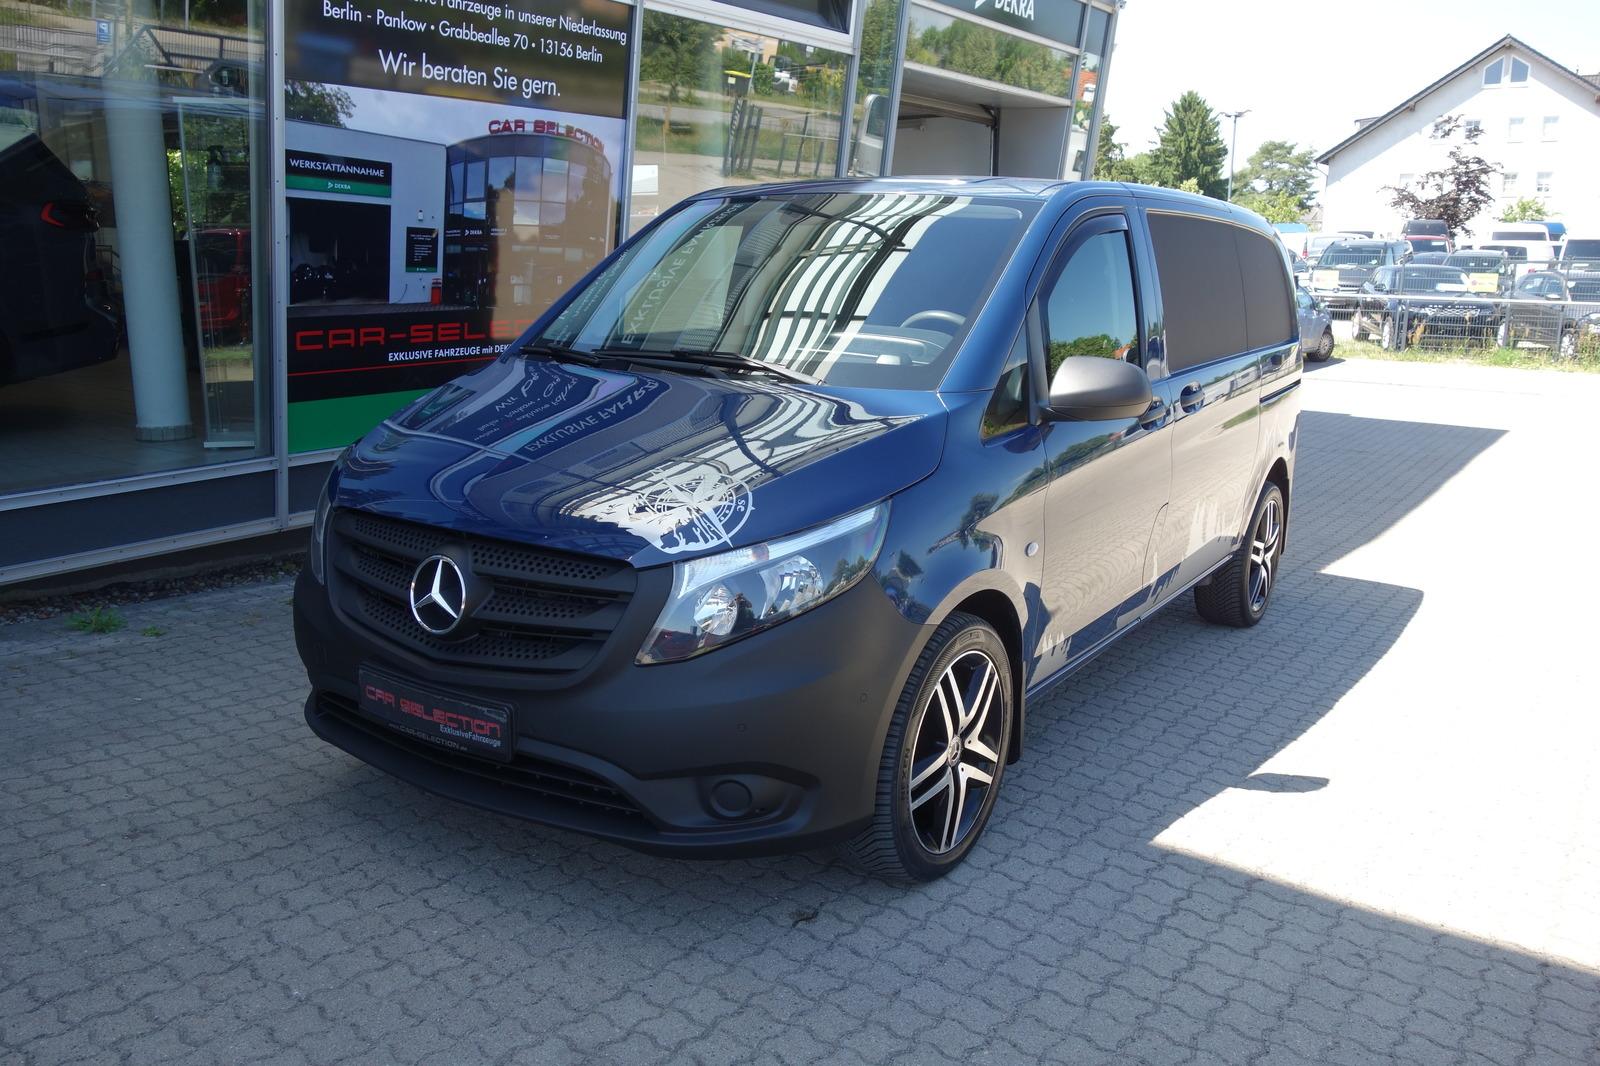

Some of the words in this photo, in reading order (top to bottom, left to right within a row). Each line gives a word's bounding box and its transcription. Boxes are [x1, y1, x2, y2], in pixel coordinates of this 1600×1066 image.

[323, 1, 362, 23] Berlin
[376, 9, 426, 33] Pankow
[439, 21, 511, 48] Grabbeallee
[513, 33, 529, 50] 70
[540, 38, 574, 58] 13156
[576, 44, 603, 63] Berlin
[505, 7, 515, 19] in
[518, 11, 557, 28] unserer
[559, 16, 628, 45] Niederlassung
[378, 49, 416, 77] Wir
[422, 53, 487, 87] beraten
[493, 66, 518, 91] Sie
[522, 75, 561, 99] gern.
[488, 119, 525, 134] CAR
[289, 158, 385, 177] WERKSTATTANNAHME
[388, 350, 433, 362] EXKLUSIVE
[434, 346, 480, 358] FAHRZEUGE
[482, 346, 493, 354] mit
[495, 344, 511, 353] DEK
[364, 685, 395, 707] CAR
[399, 700, 500, 737] SELECTION
